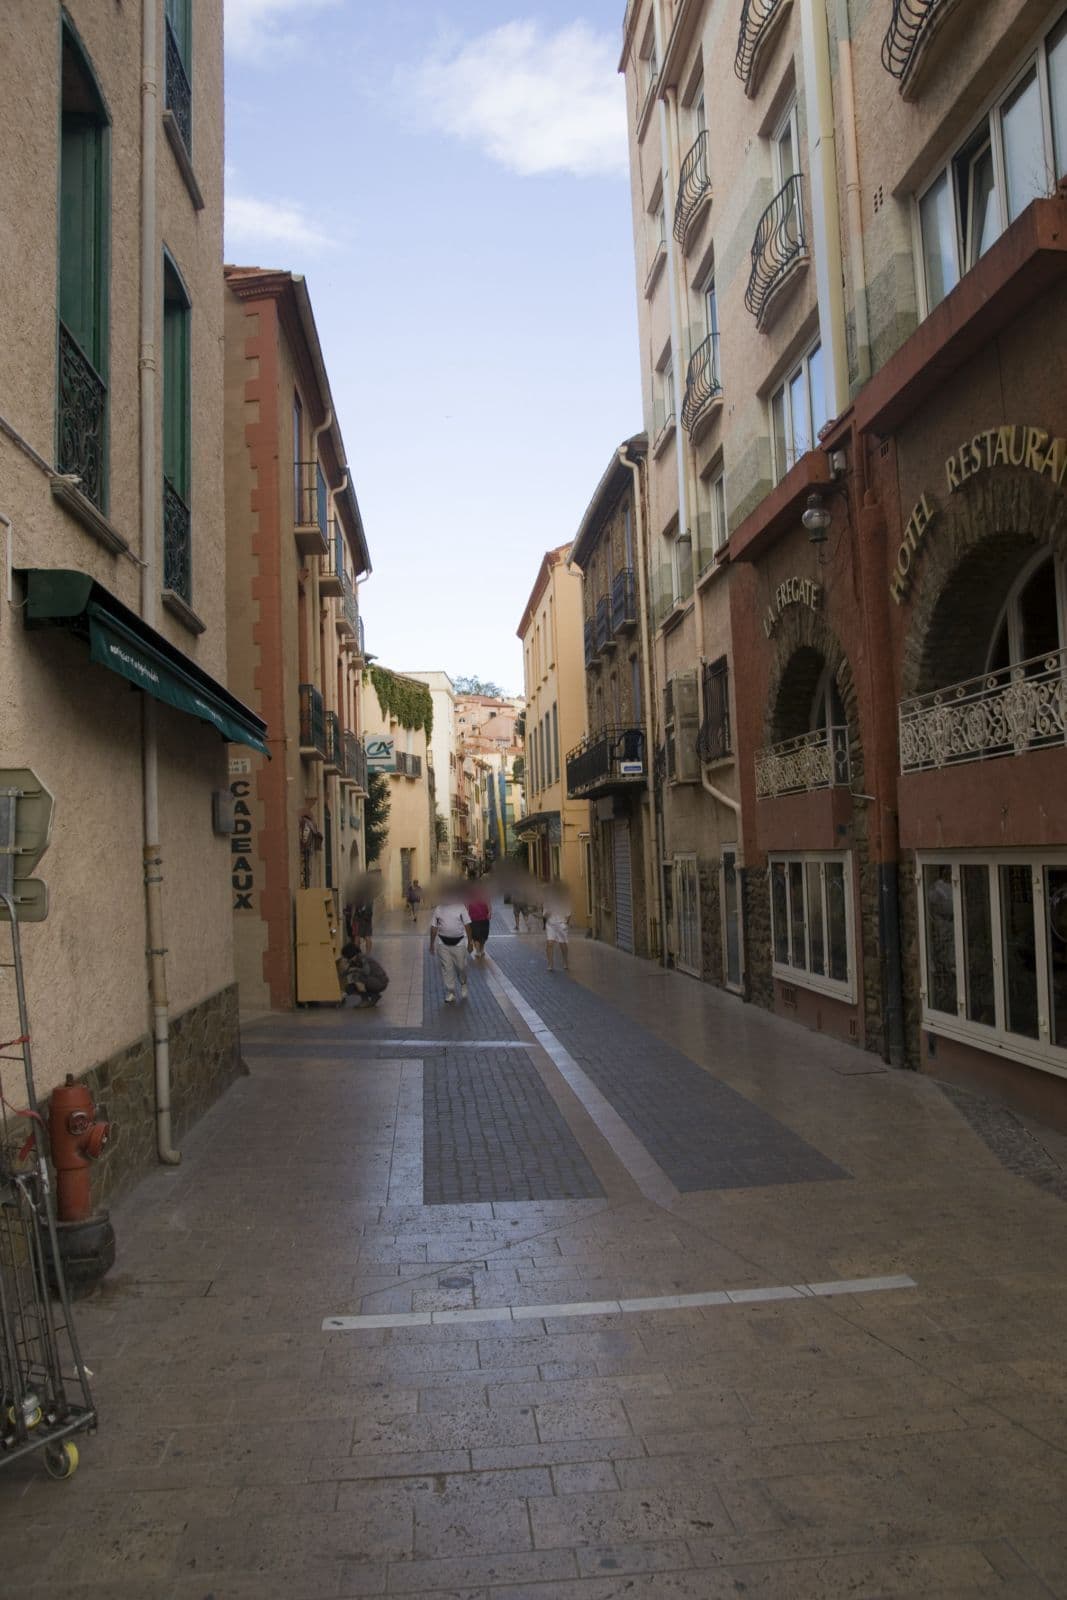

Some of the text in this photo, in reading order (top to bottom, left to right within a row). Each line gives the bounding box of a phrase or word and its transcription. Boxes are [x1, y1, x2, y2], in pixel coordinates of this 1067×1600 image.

[889, 492, 934, 606] HOTEL
[763, 576, 817, 638] LA FREGATE
[230, 781, 254, 910] CADEAUX
